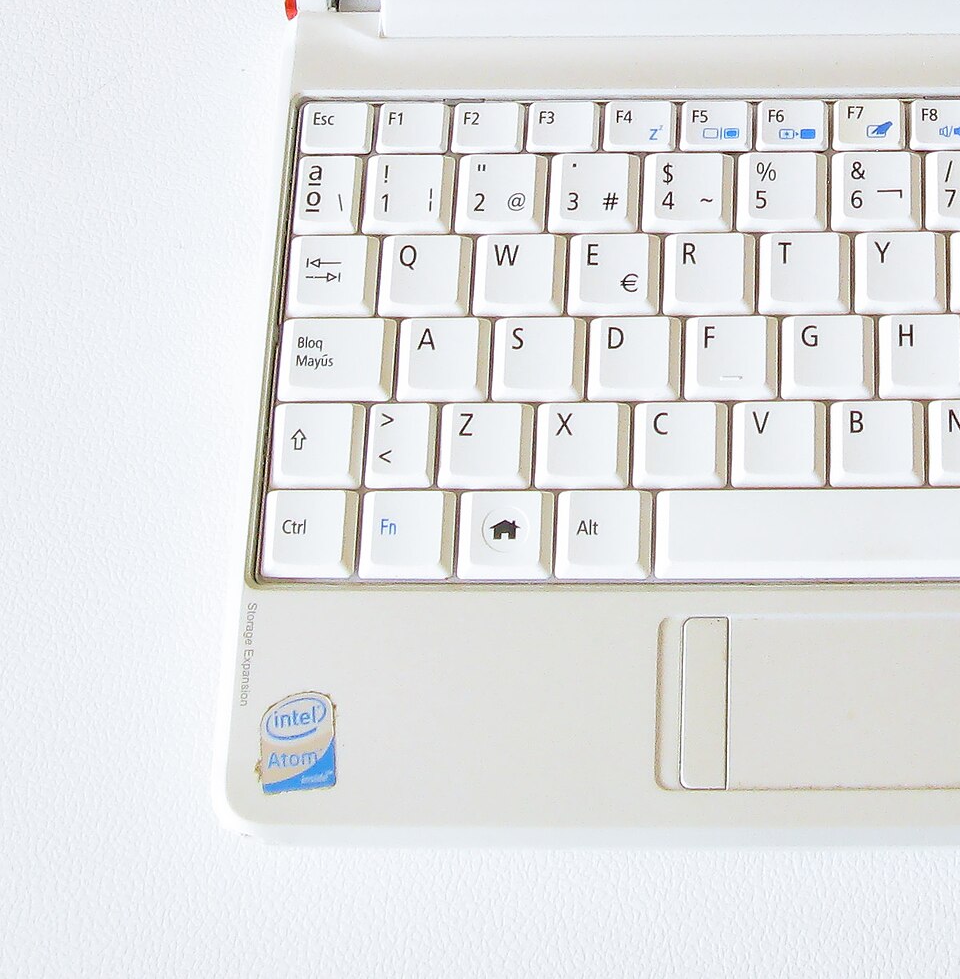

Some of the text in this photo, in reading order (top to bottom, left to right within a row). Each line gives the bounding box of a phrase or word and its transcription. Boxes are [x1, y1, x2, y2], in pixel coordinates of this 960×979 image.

[314, 112, 334, 125] Esc
[389, 112, 402, 125] F1
[464, 112, 479, 125] F2
[539, 111, 554, 124] F3
[617, 110, 632, 123] F4
[692, 110, 708, 123] F5
[769, 110, 784, 122] F6
[848, 106, 863, 119] F7
[922, 108, 938, 121] F8
[663, 163, 673, 185] $
[757, 162, 776, 181] %
[851, 162, 865, 179] &
[381, 193, 389, 213] 1
[474, 193, 485, 211] 2
[508, 193, 525, 211] @
[567, 193, 578, 210] 3
[603, 193, 618, 210] #
[662, 191, 674, 209] 4
[756, 191, 766, 209] 5
[851, 190, 862, 208] 6
[945, 189, 956, 207] 7
[400, 245, 416, 270] Q
[494, 245, 519, 266] W
[587, 244, 598, 265] E
[683, 243, 696, 264] R
[778, 242, 791, 264] T
[875, 242, 890, 263] Y
[621, 274, 638, 292] €
[298, 337, 322, 351] Bloq
[418, 328, 435, 350] A
[512, 328, 523, 349] S
[608, 327, 624, 349] D
[704, 326, 715, 348] F
[802, 325, 817, 347] G
[899, 324, 913, 346] H
[296, 354, 333, 369] Mayús
[459, 414, 473, 436] Z
[556, 413, 572, 435] X
[654, 413, 668, 435] C
[753, 412, 769, 434] V
[850, 411, 863, 433] B
[282, 519, 306, 534] Ctrl
[381, 519, 396, 534] Fn
[577, 519, 598, 535] Alt
[240, 603, 257, 707] Storage Expansion
[274, 706, 318, 728] intel
[268, 751, 318, 769] Atom
